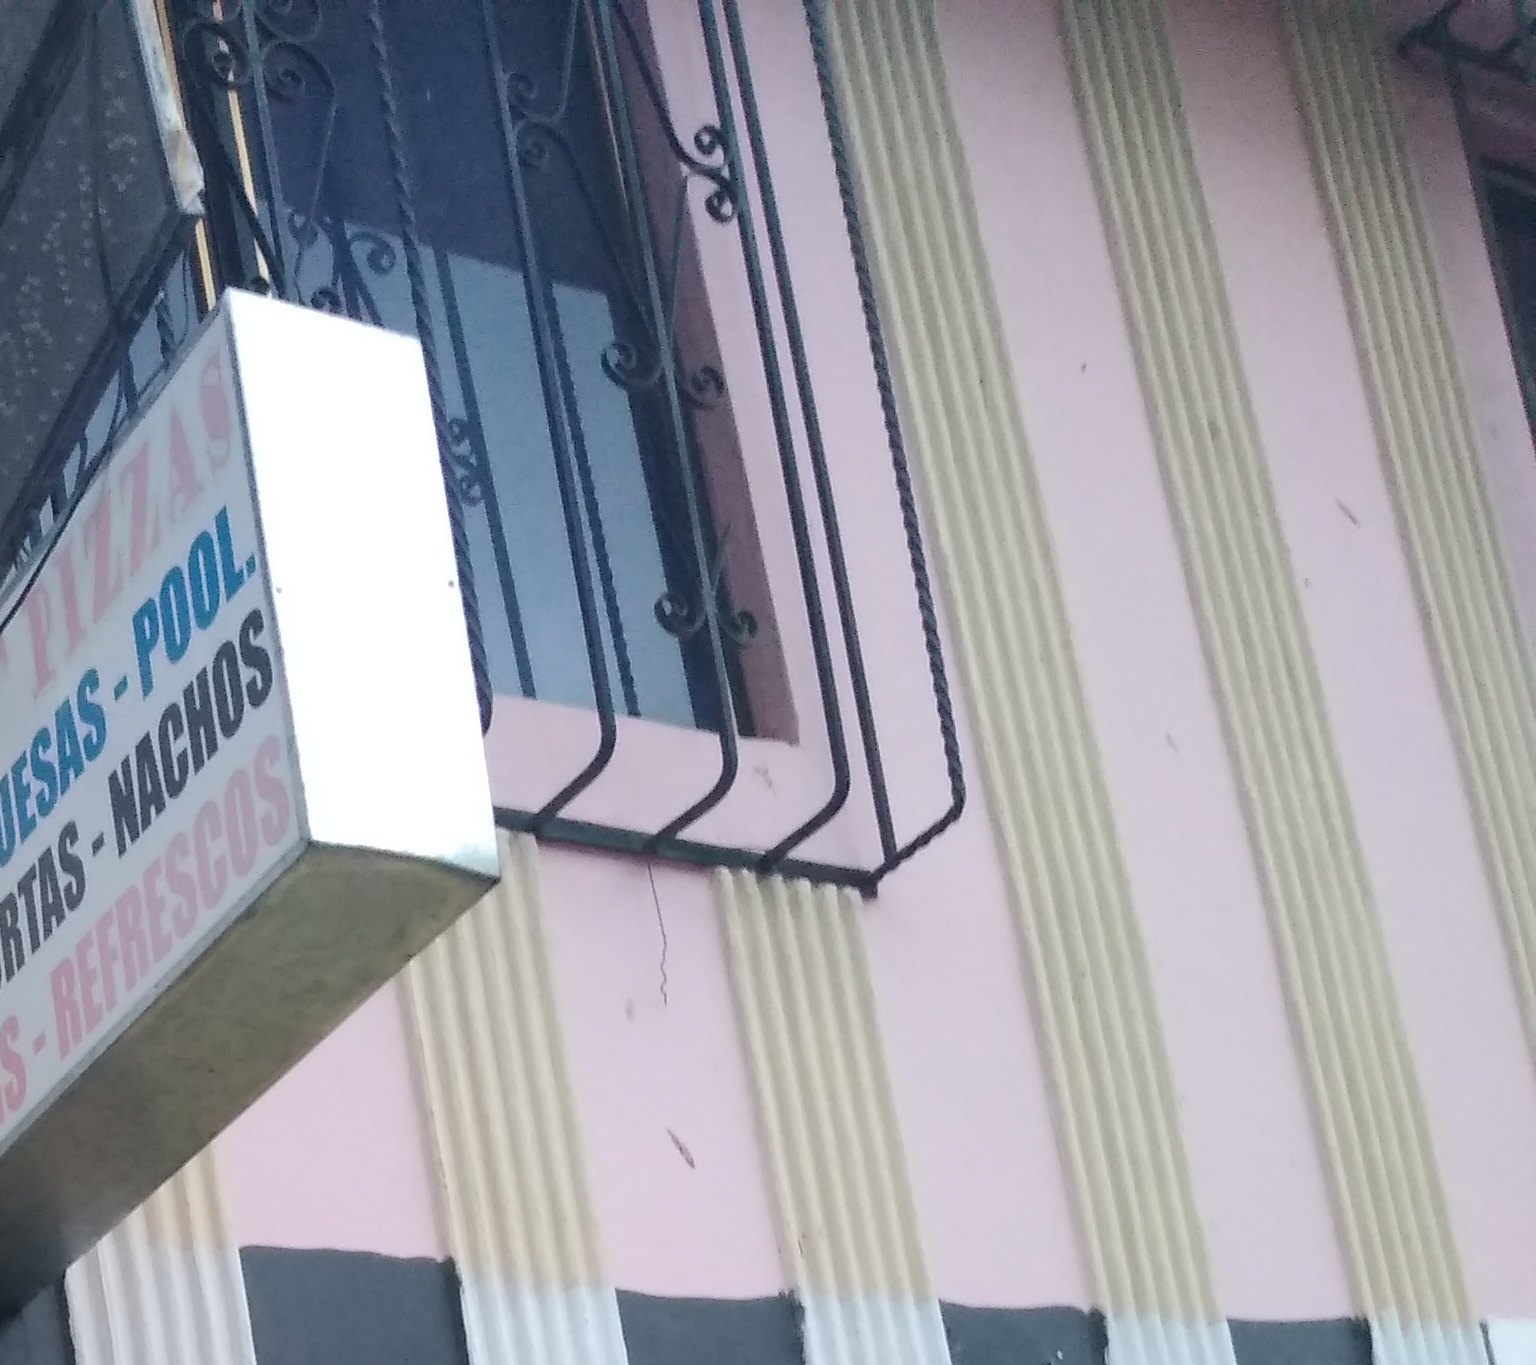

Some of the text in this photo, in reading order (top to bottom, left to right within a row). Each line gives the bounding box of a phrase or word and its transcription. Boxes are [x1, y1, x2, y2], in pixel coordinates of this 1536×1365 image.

[19, 354, 237, 699] PIZZAS
[131, 505, 257, 700] POOL.
[106, 606, 274, 859] NACHOS
[51, 736, 290, 1062] REFRESCOS
